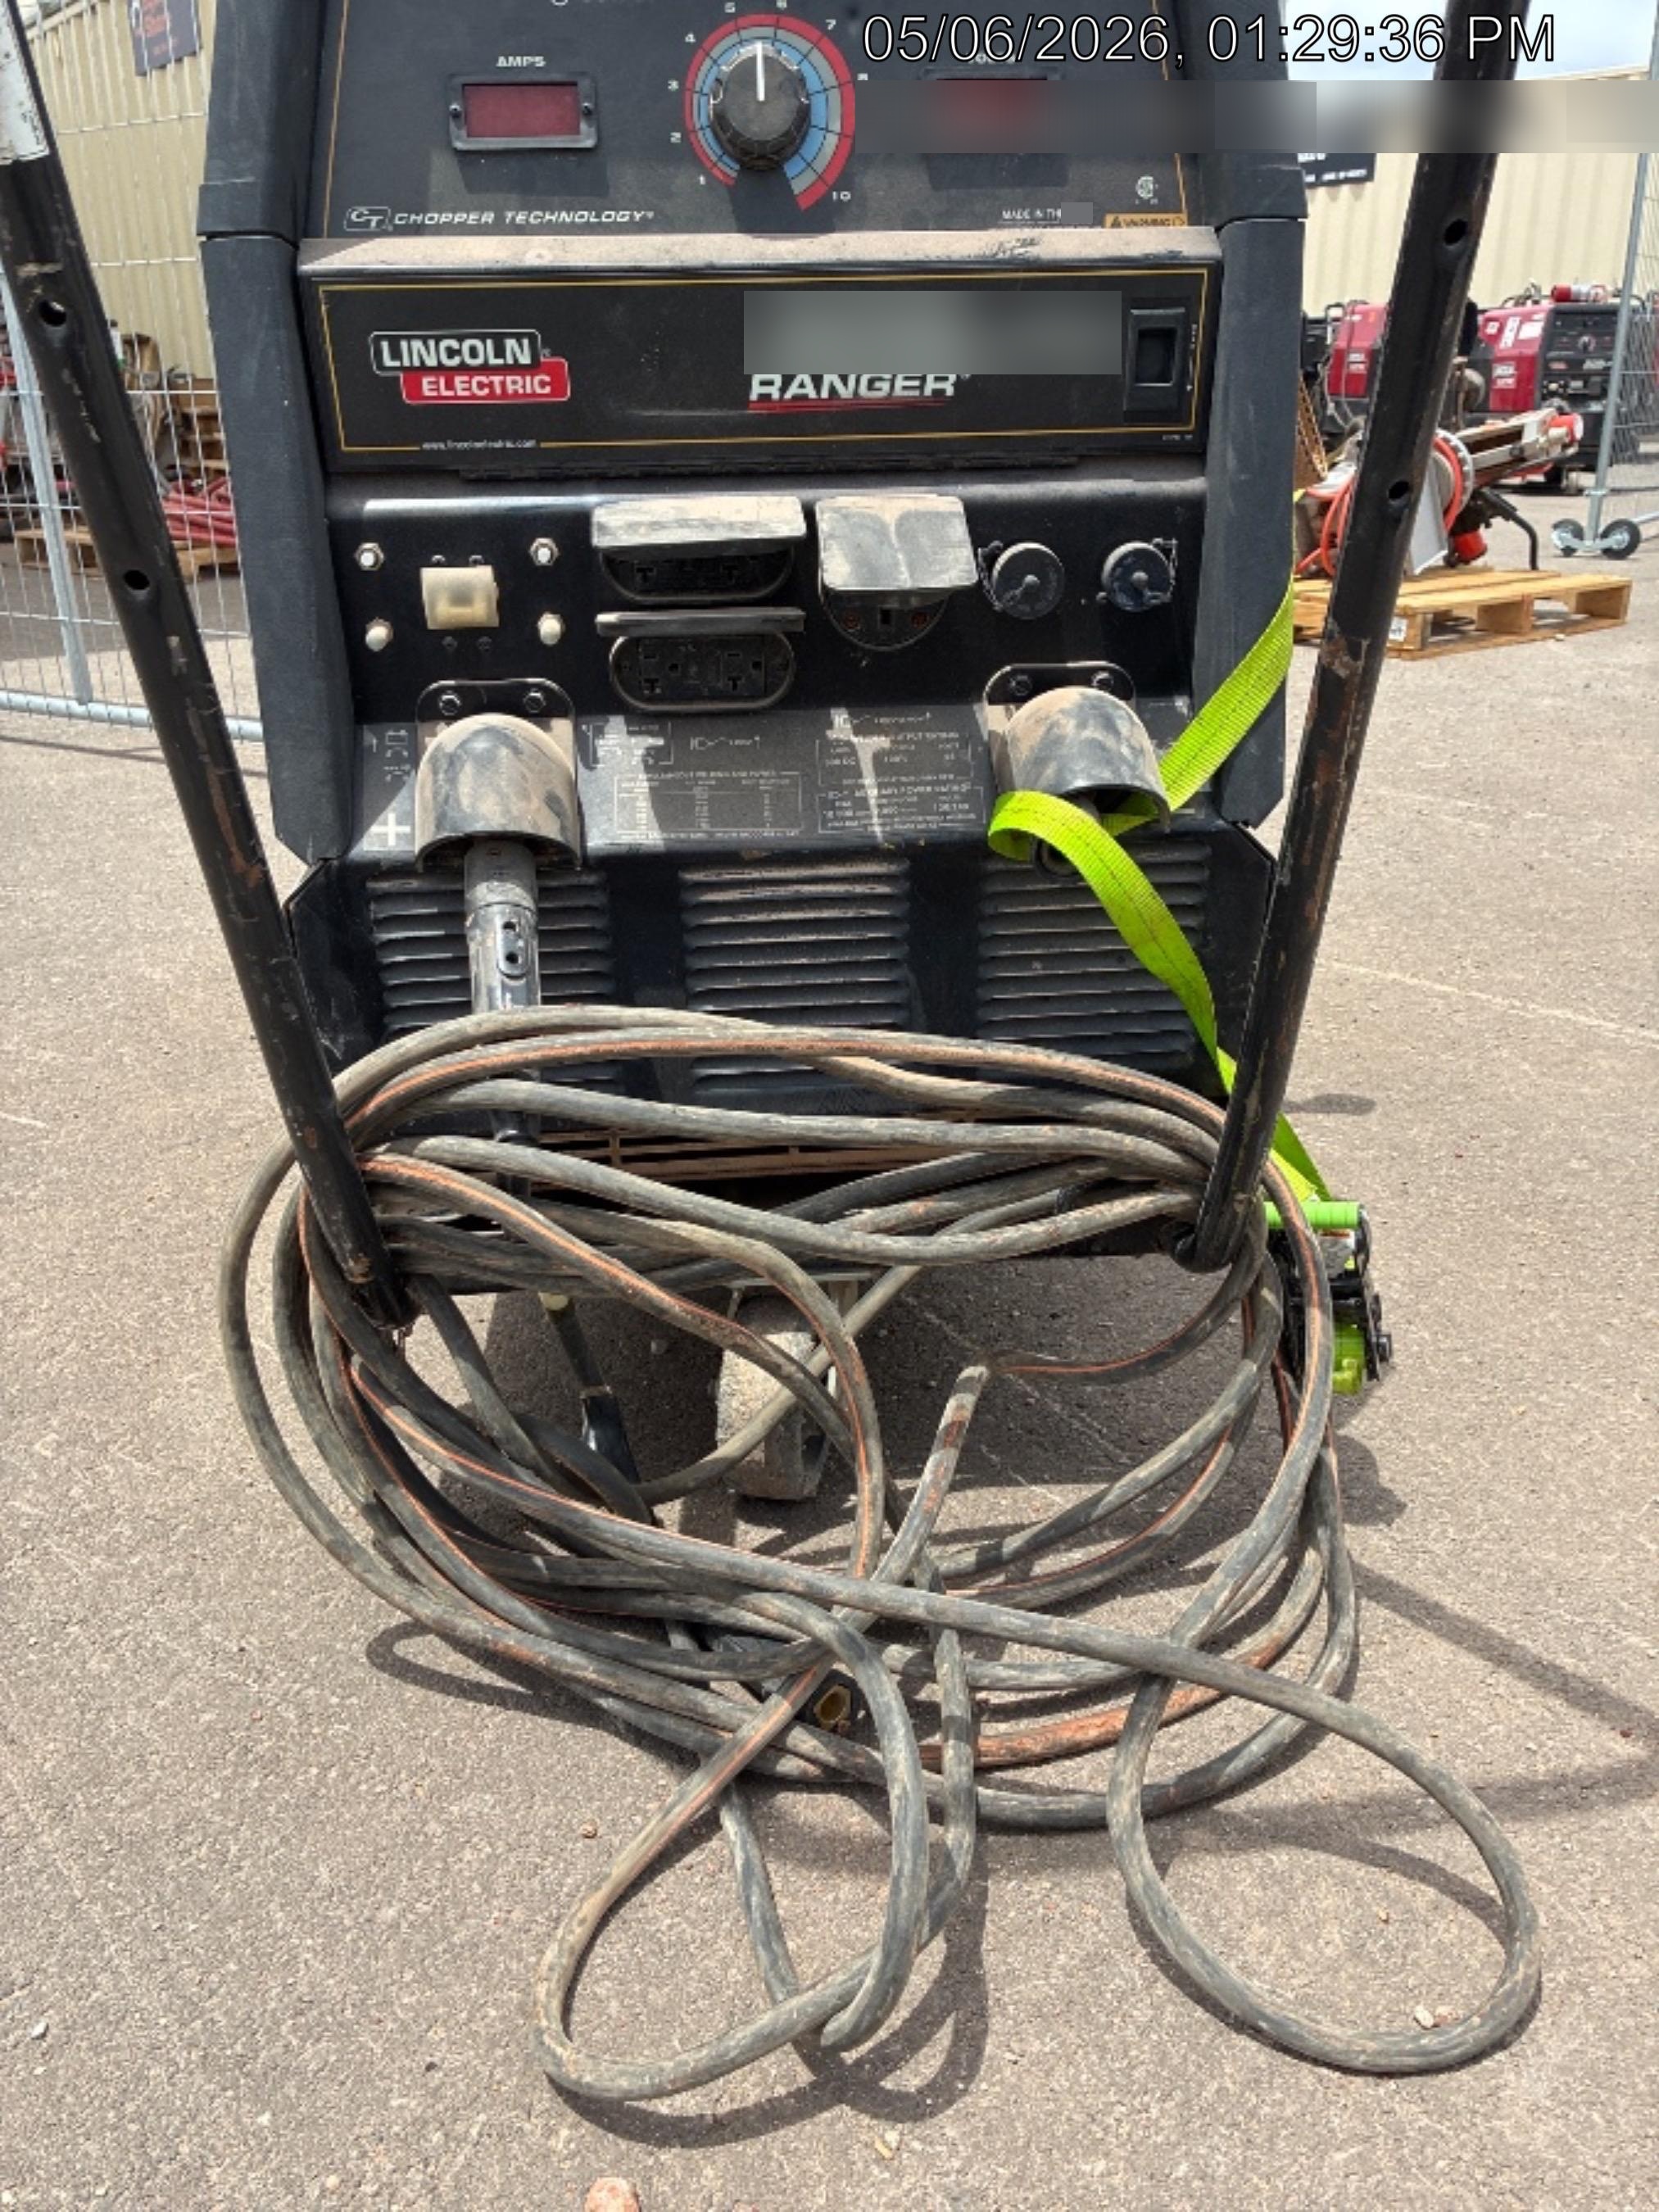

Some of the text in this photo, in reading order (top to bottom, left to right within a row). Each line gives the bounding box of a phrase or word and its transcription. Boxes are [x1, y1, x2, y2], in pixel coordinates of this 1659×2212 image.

[826, 19, 836, 30] 7
[685, 34, 696, 43] 4
[496, 55, 546, 68] AMPS
[668, 80, 678, 91] 3
[670, 132, 681, 143] 2
[700, 175, 705, 185] 1
[832, 191, 850, 202] 10
[393, 212, 495, 224] CHOPPER
[380, 338, 532, 367] LINCOLN
[422, 374, 551, 397] ELECTRIC
[749, 374, 957, 401] RANGER
